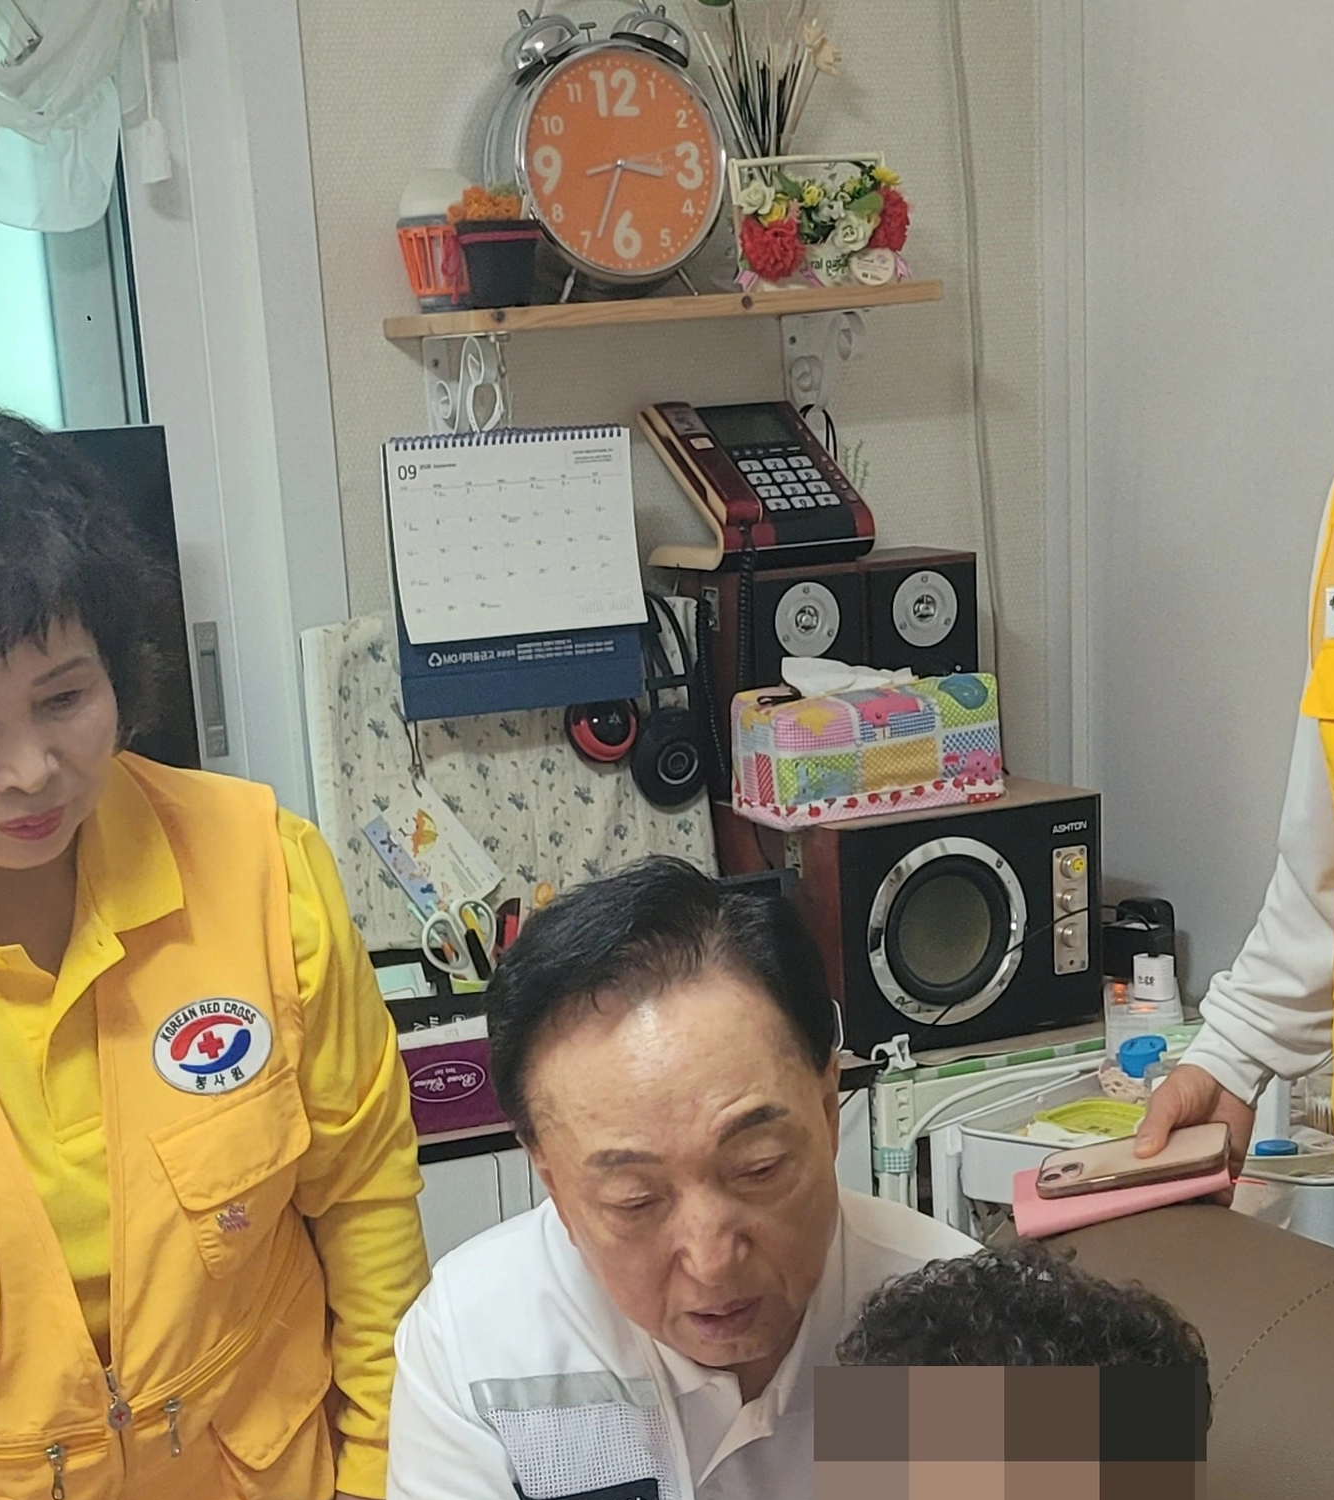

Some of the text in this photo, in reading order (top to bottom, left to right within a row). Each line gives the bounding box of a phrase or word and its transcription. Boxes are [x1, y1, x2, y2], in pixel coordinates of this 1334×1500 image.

[567, 83, 583, 103] 11
[589, 68, 640, 117] 12
[647, 80, 656, 99] 1
[540, 115, 564, 136] 10
[676, 110, 688, 128] 2
[533, 145, 563, 195] 9
[675, 141, 704, 190] 3
[551, 203, 564, 223] 8
[682, 199, 695, 216] 4
[580, 231, 592, 249] 7
[613, 210, 642, 259] 6
[659, 229, 671, 247] 5
[397, 465, 417, 481] 09
[1052, 820, 1088, 834] ASHTON
[160, 1002, 257, 1042] KOREAN RED CROSS
[195, 1066, 245, 1091] 봉사원
